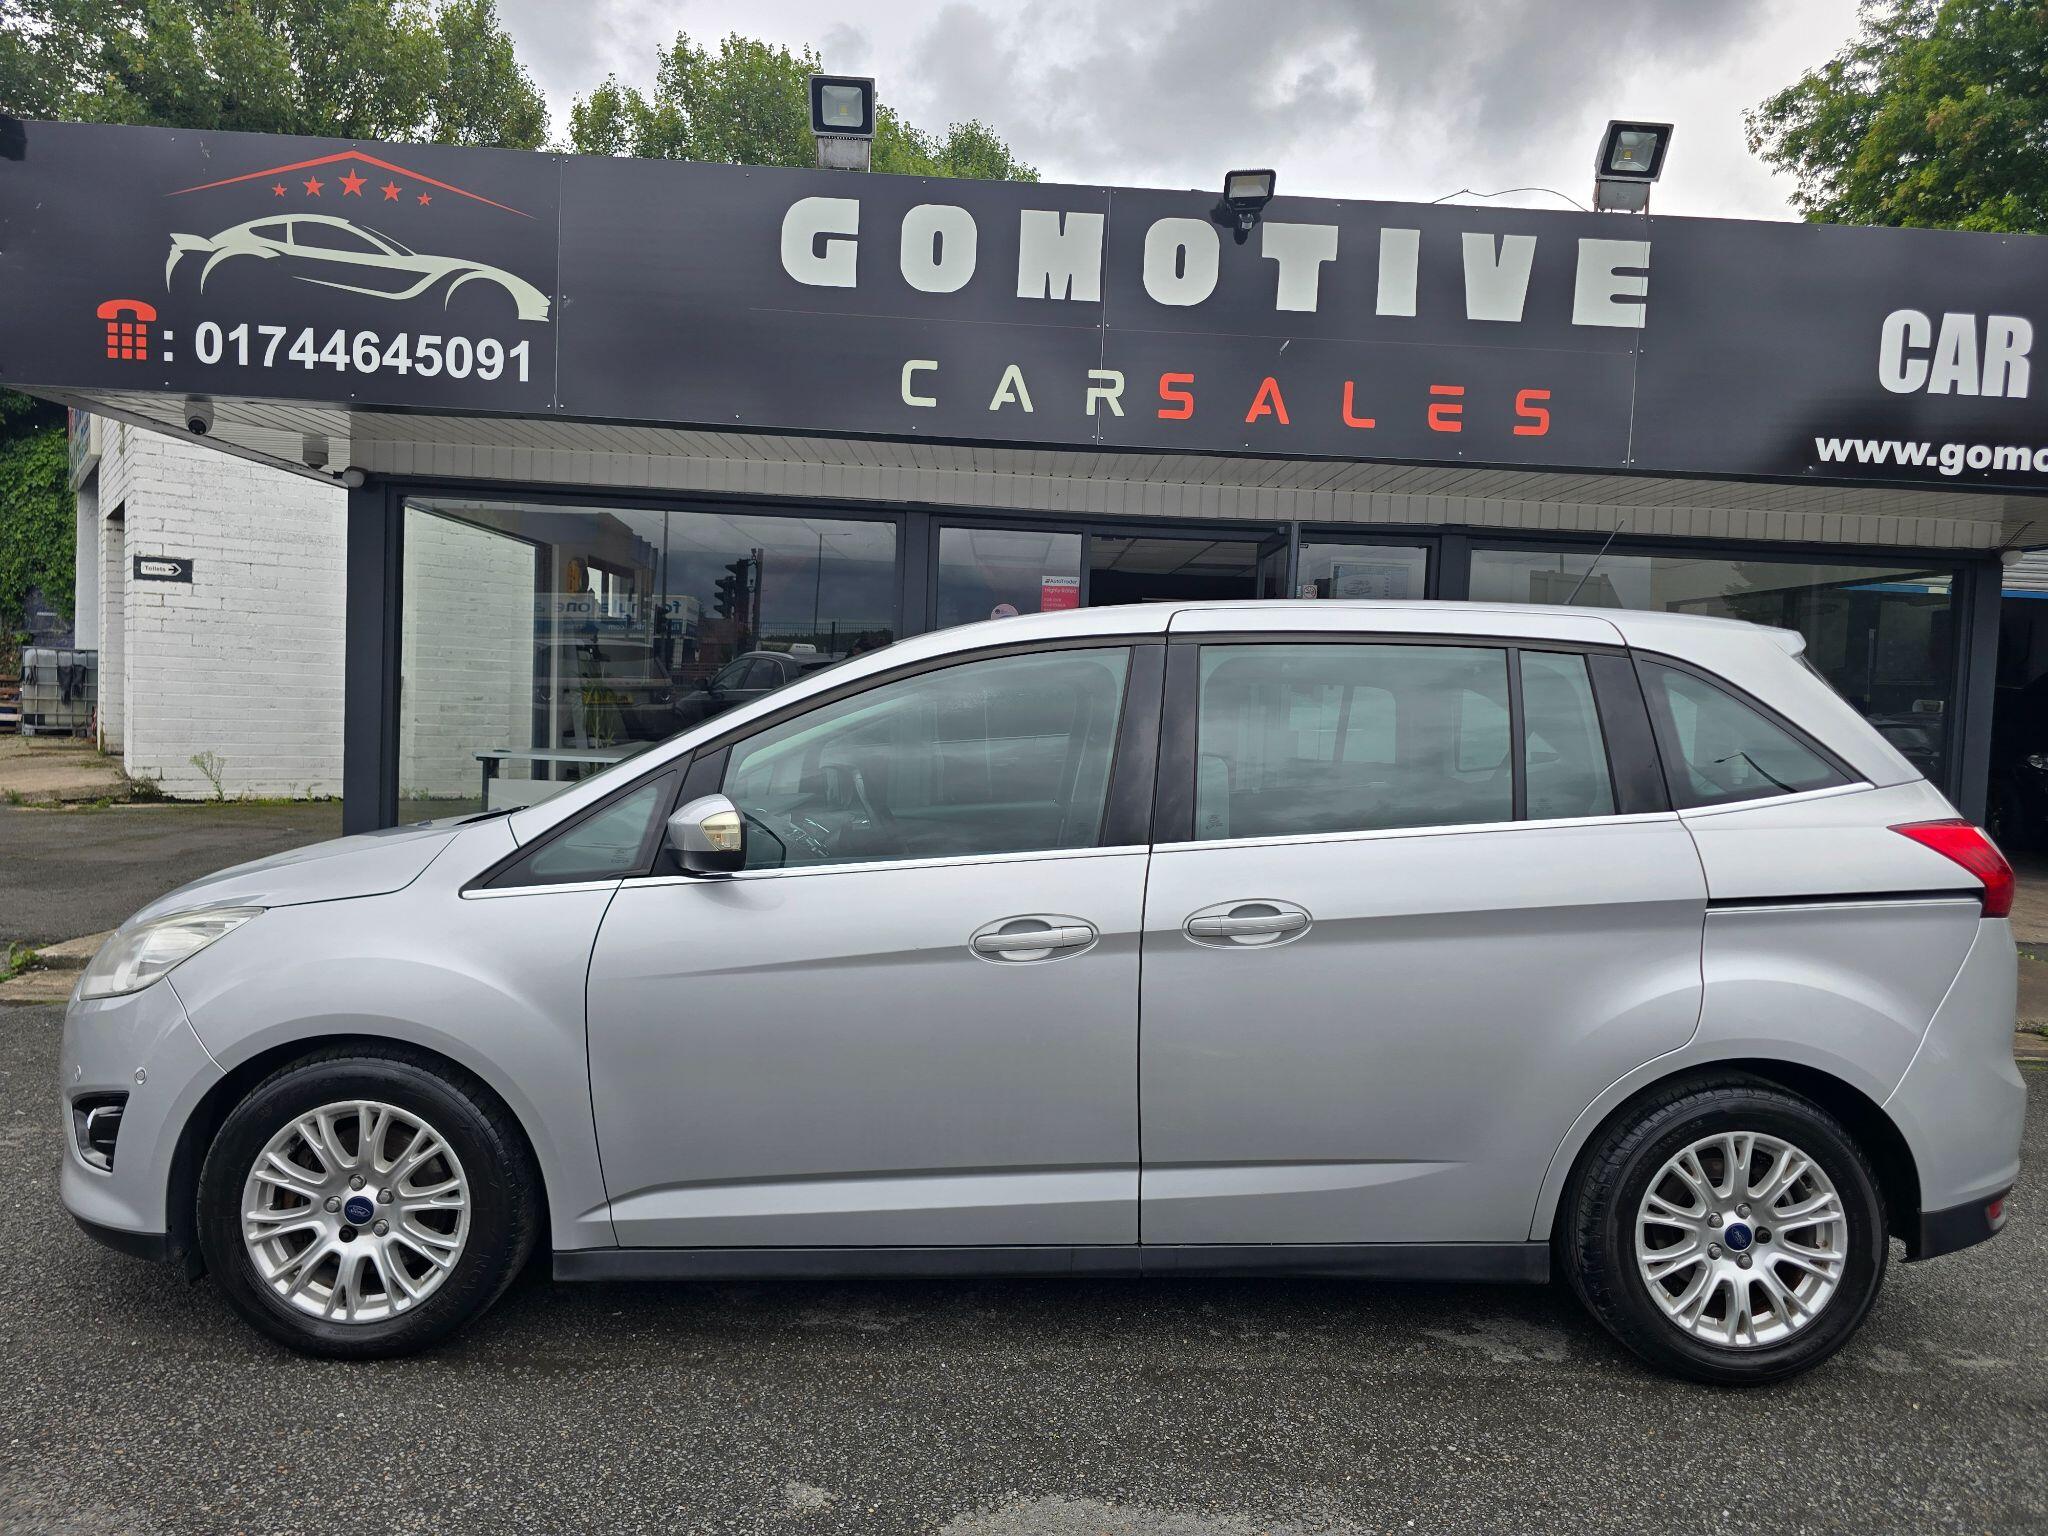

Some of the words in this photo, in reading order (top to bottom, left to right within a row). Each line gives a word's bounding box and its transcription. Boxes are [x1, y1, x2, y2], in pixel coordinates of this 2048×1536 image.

[781, 196, 1651, 328] GOMOTIVE
[195, 321, 531, 382] 01744645091
[1879, 310, 2033, 398] CAR
